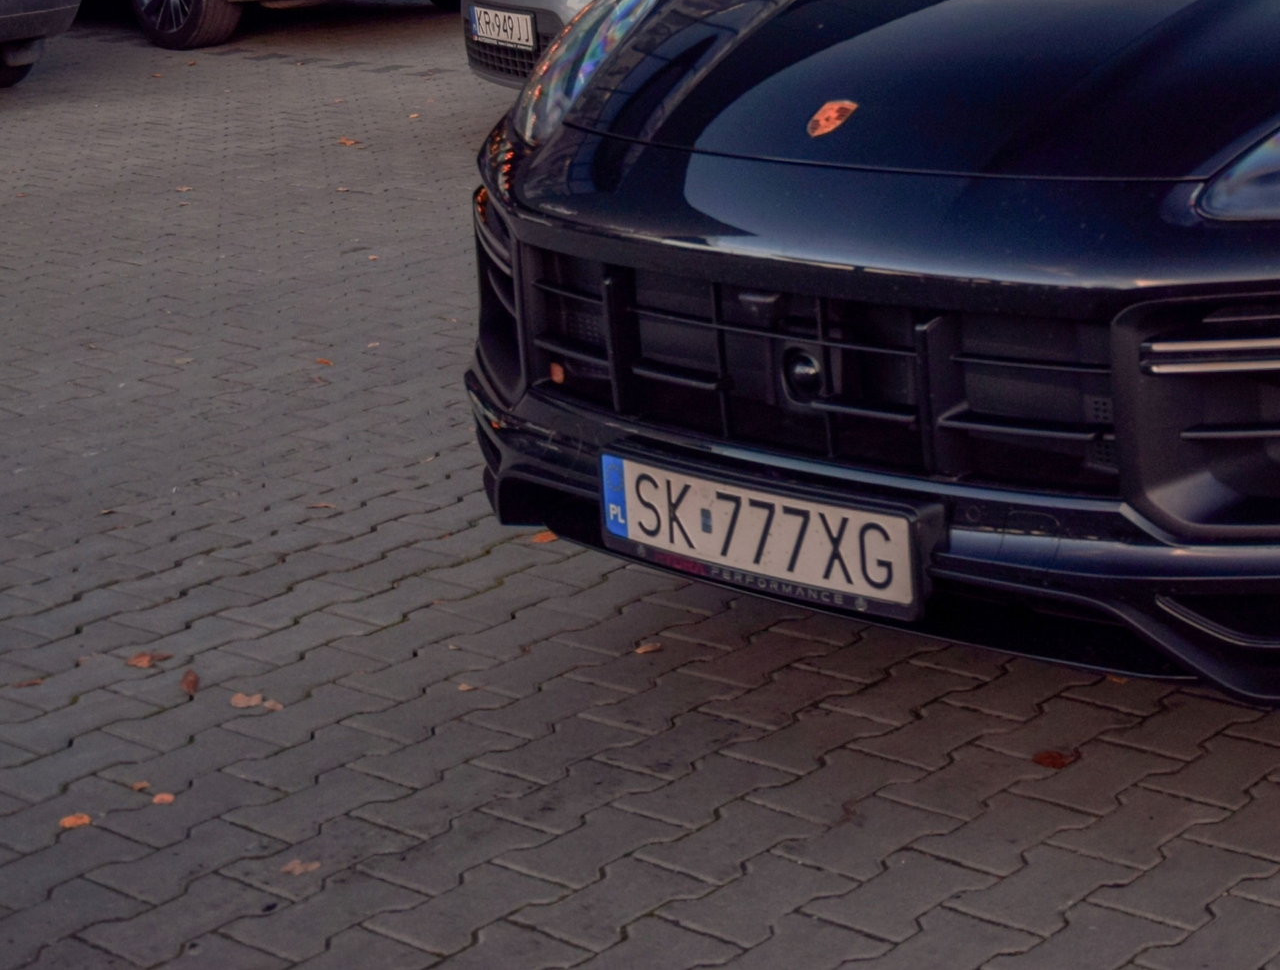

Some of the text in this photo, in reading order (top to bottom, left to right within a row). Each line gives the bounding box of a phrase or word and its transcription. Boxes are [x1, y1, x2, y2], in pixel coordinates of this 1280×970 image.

[475, 9, 530, 43] KR 949JJ
[609, 503, 626, 524] PL
[635, 473, 894, 590] SK 777XG
[711, 566, 843, 606] PERFORMANCE
